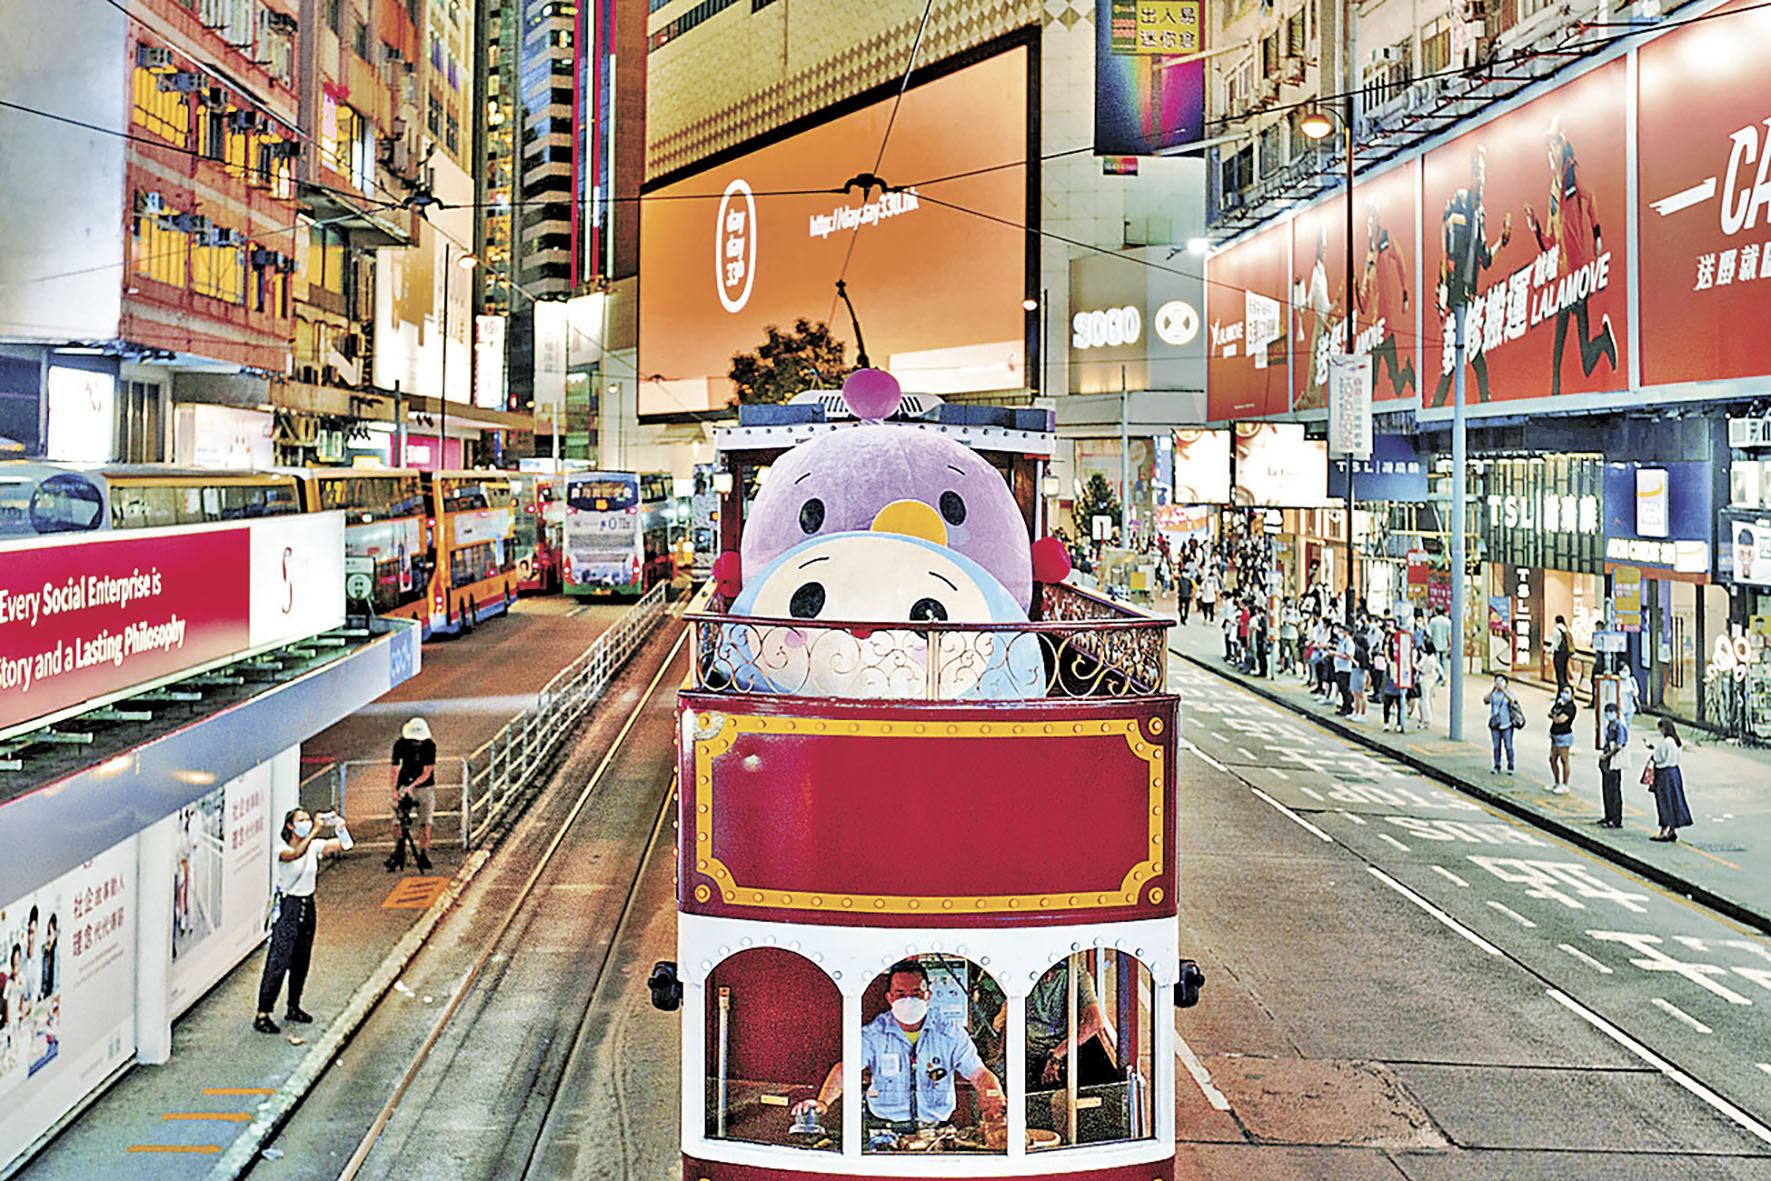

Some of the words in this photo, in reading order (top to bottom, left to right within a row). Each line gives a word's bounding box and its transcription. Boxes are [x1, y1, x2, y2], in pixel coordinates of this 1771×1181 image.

[726, 208, 746, 235] day
[726, 234, 746, 261] day
[1530, 251, 1611, 328] LALAMOVE
[1072, 305, 1142, 350] SOGO
[1336, 461, 1374, 474] TSL
[1487, 494, 1535, 529] TSL
[0, 588, 41, 627] Every
[42, 575, 86, 616] Social
[87, 567, 150, 609] Enterprise
[151, 566, 162, 596] is
[34, 639, 62, 681] and
[64, 646, 74, 672] a
[75, 629, 123, 667] Lasting
[124, 612, 187, 656] Philosophy
